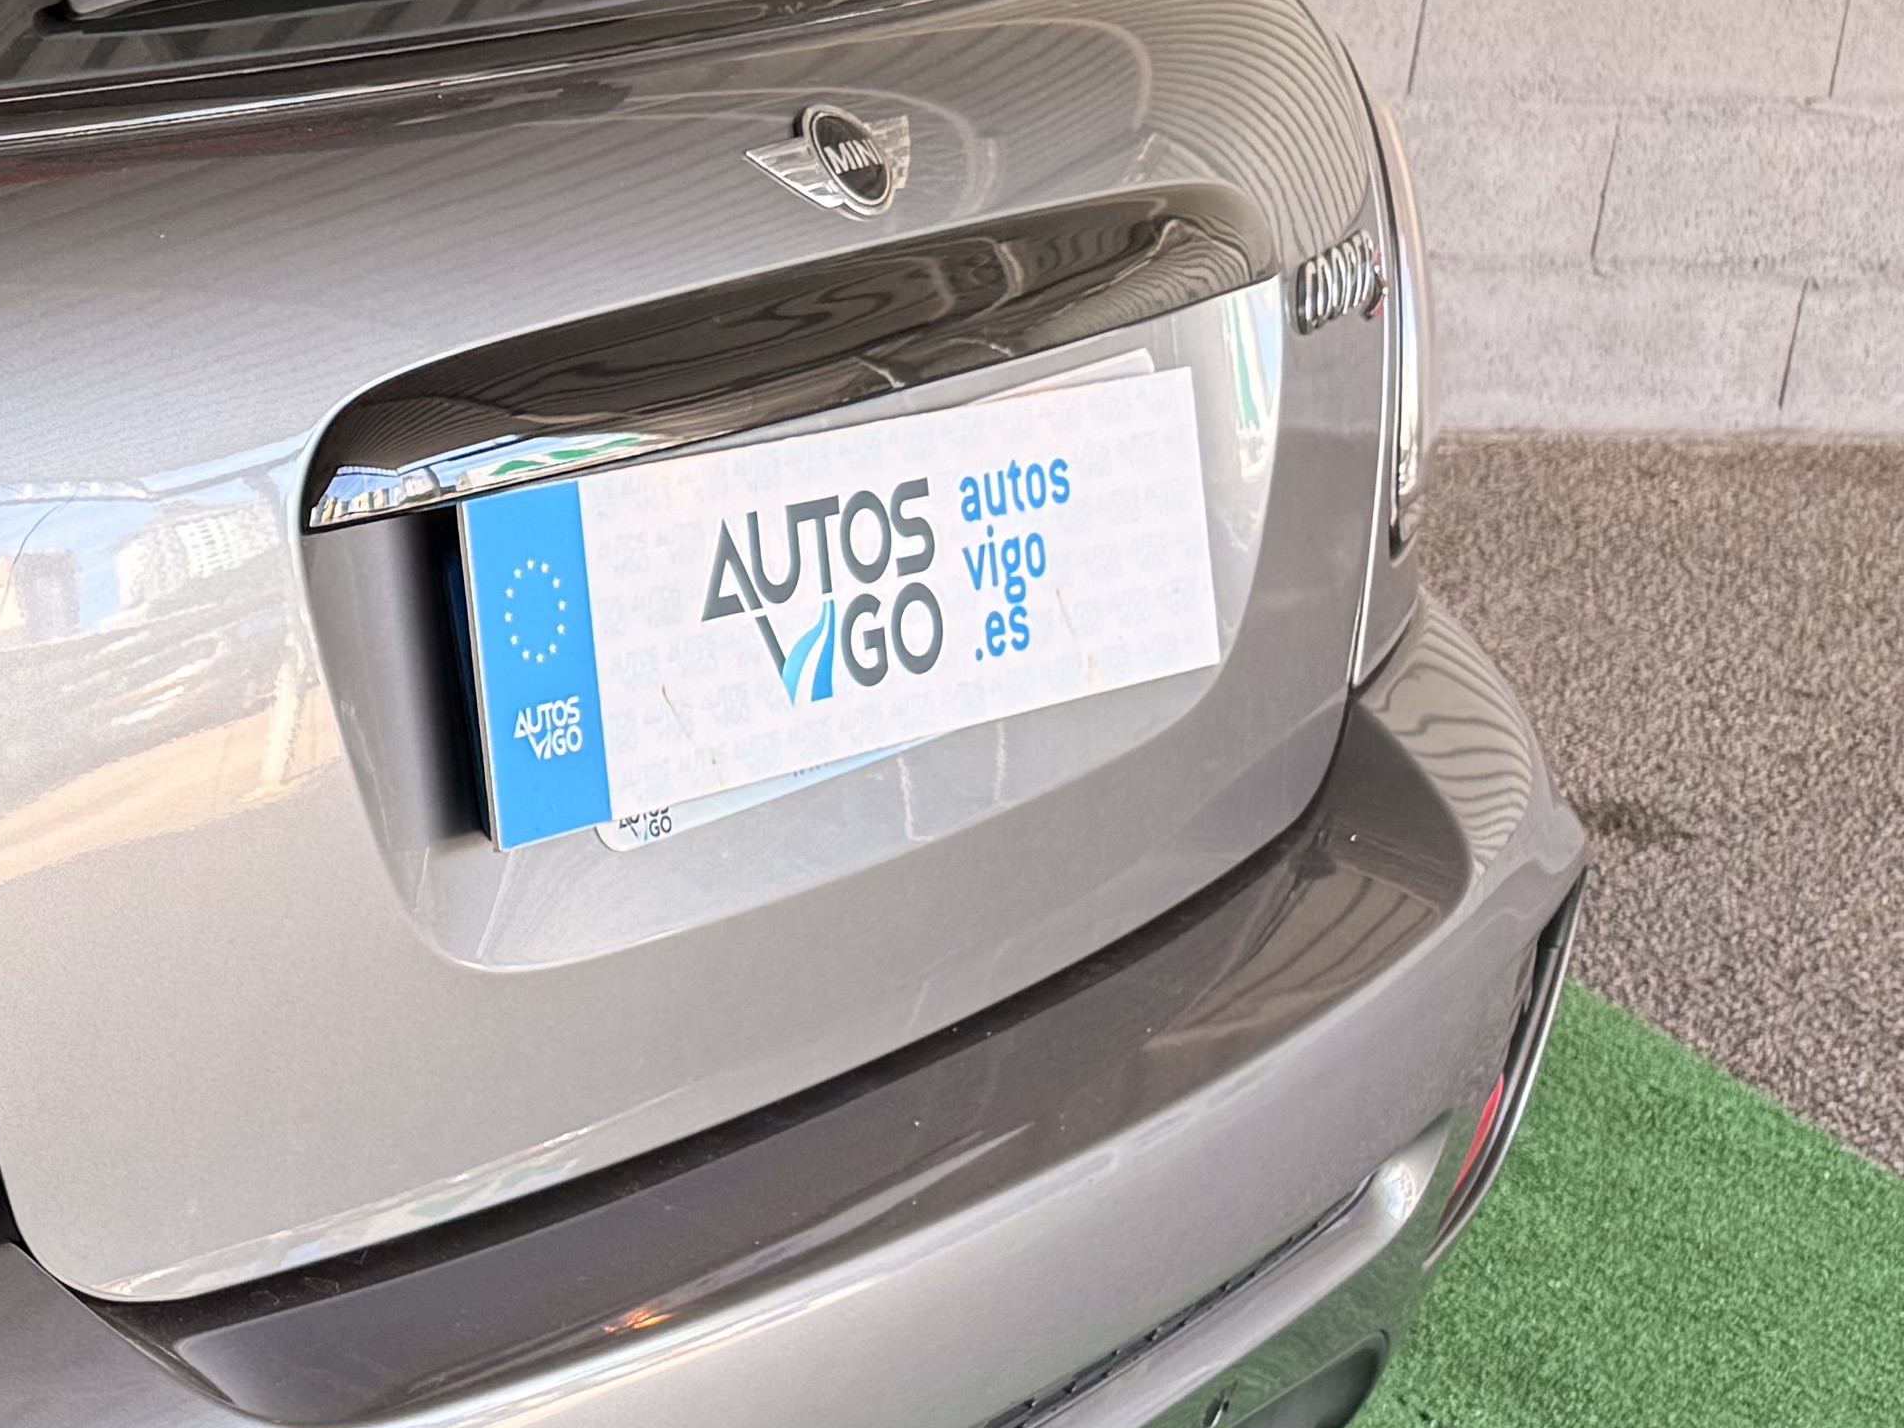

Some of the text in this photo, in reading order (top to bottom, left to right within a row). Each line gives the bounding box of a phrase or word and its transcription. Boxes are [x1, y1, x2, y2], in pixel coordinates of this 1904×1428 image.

[824, 138, 884, 176] MINI
[959, 457, 1070, 522] autos
[702, 477, 936, 622] AUTOS
[961, 526, 1046, 605] vigo
[754, 581, 943, 707] VIGO
[974, 603, 1030, 662] .es
[513, 695, 581, 739] AUTOS
[526, 724, 583, 760] VIGO
